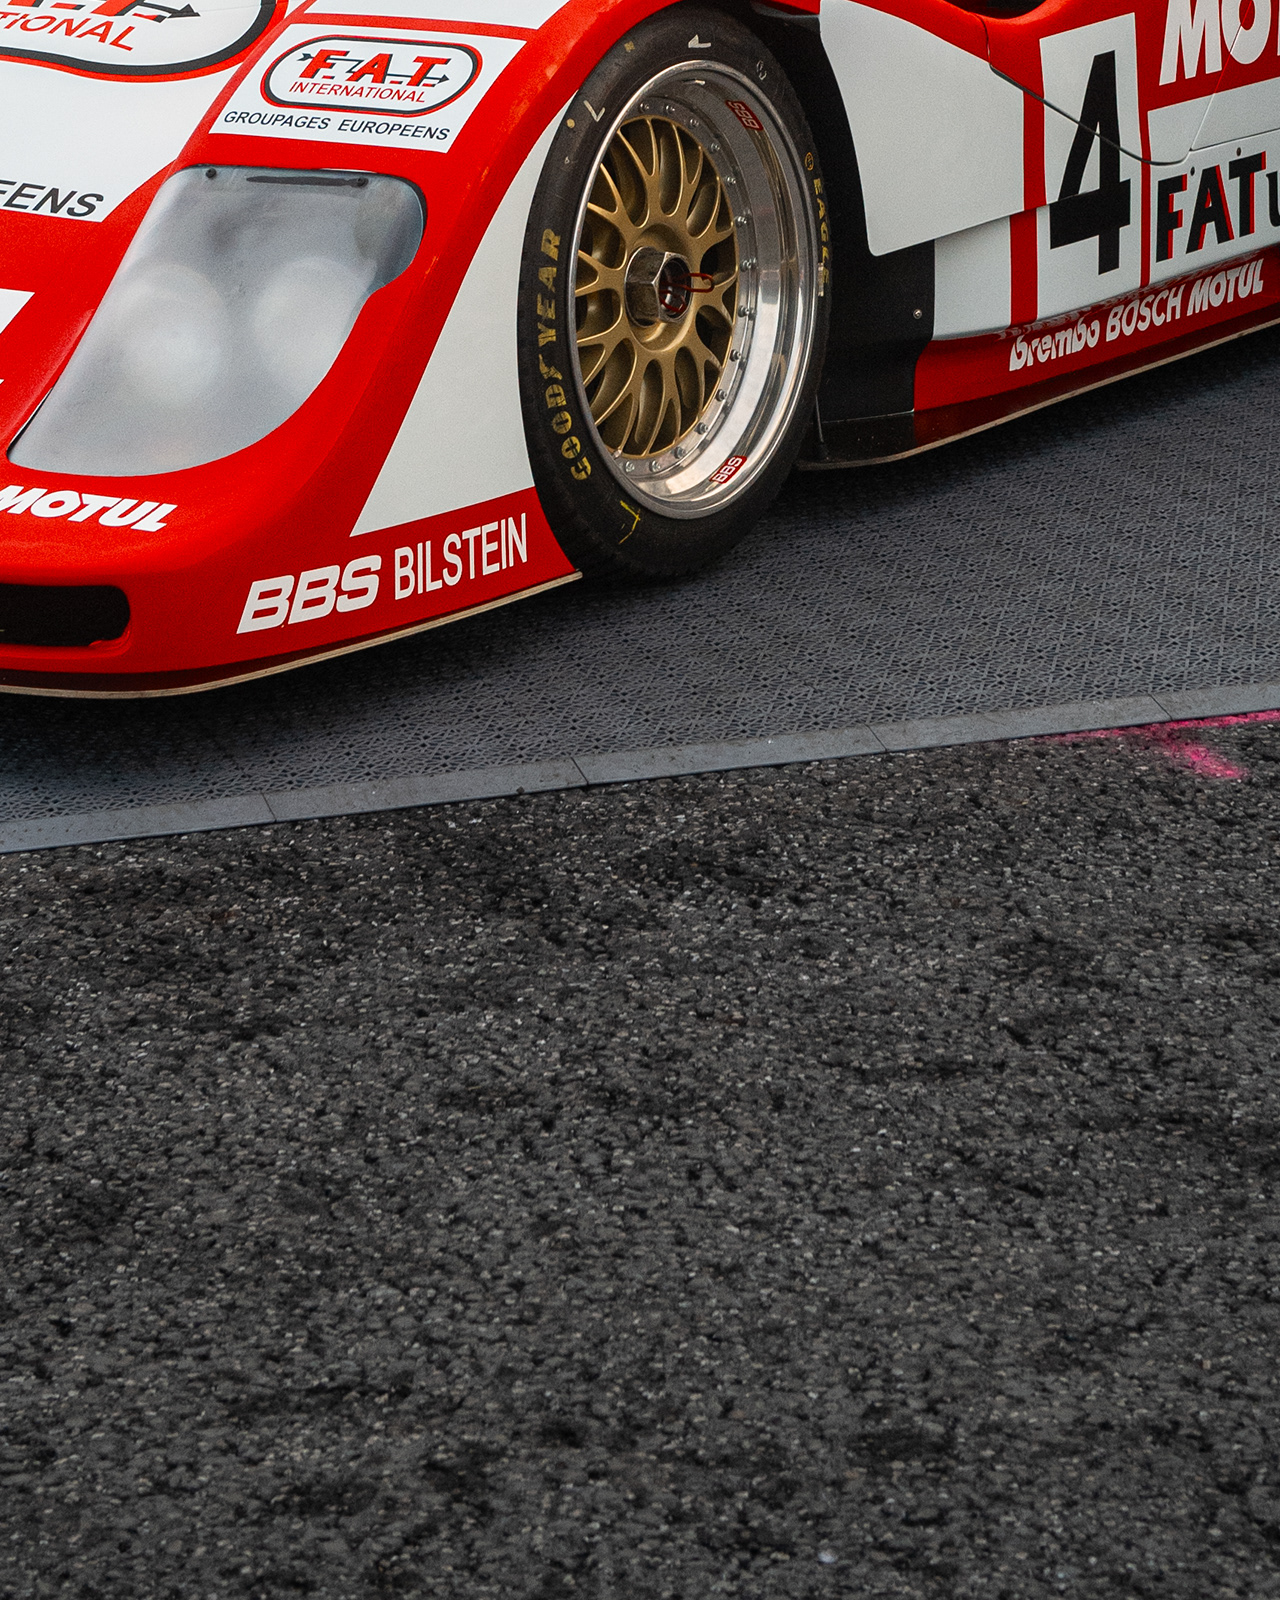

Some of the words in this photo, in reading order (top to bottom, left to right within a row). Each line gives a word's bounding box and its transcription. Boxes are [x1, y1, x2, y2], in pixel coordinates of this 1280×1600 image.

[223, 110, 331, 130] GROUPAGES
[337, 119, 451, 141] EUROPEENS
[288, 81, 426, 103] INTERNATIONAL
[1049, 49, 1131, 276] 4
[536, 228, 592, 481] GOODYEAR
[1009, 316, 1100, 371] brembo
[1105, 285, 1184, 343] BOSCH
[1186, 258, 1265, 317] MOTUL
[712, 456, 743, 482] BBS
[236, 554, 382, 635] BBS
[394, 513, 528, 601] BILSTEIN
